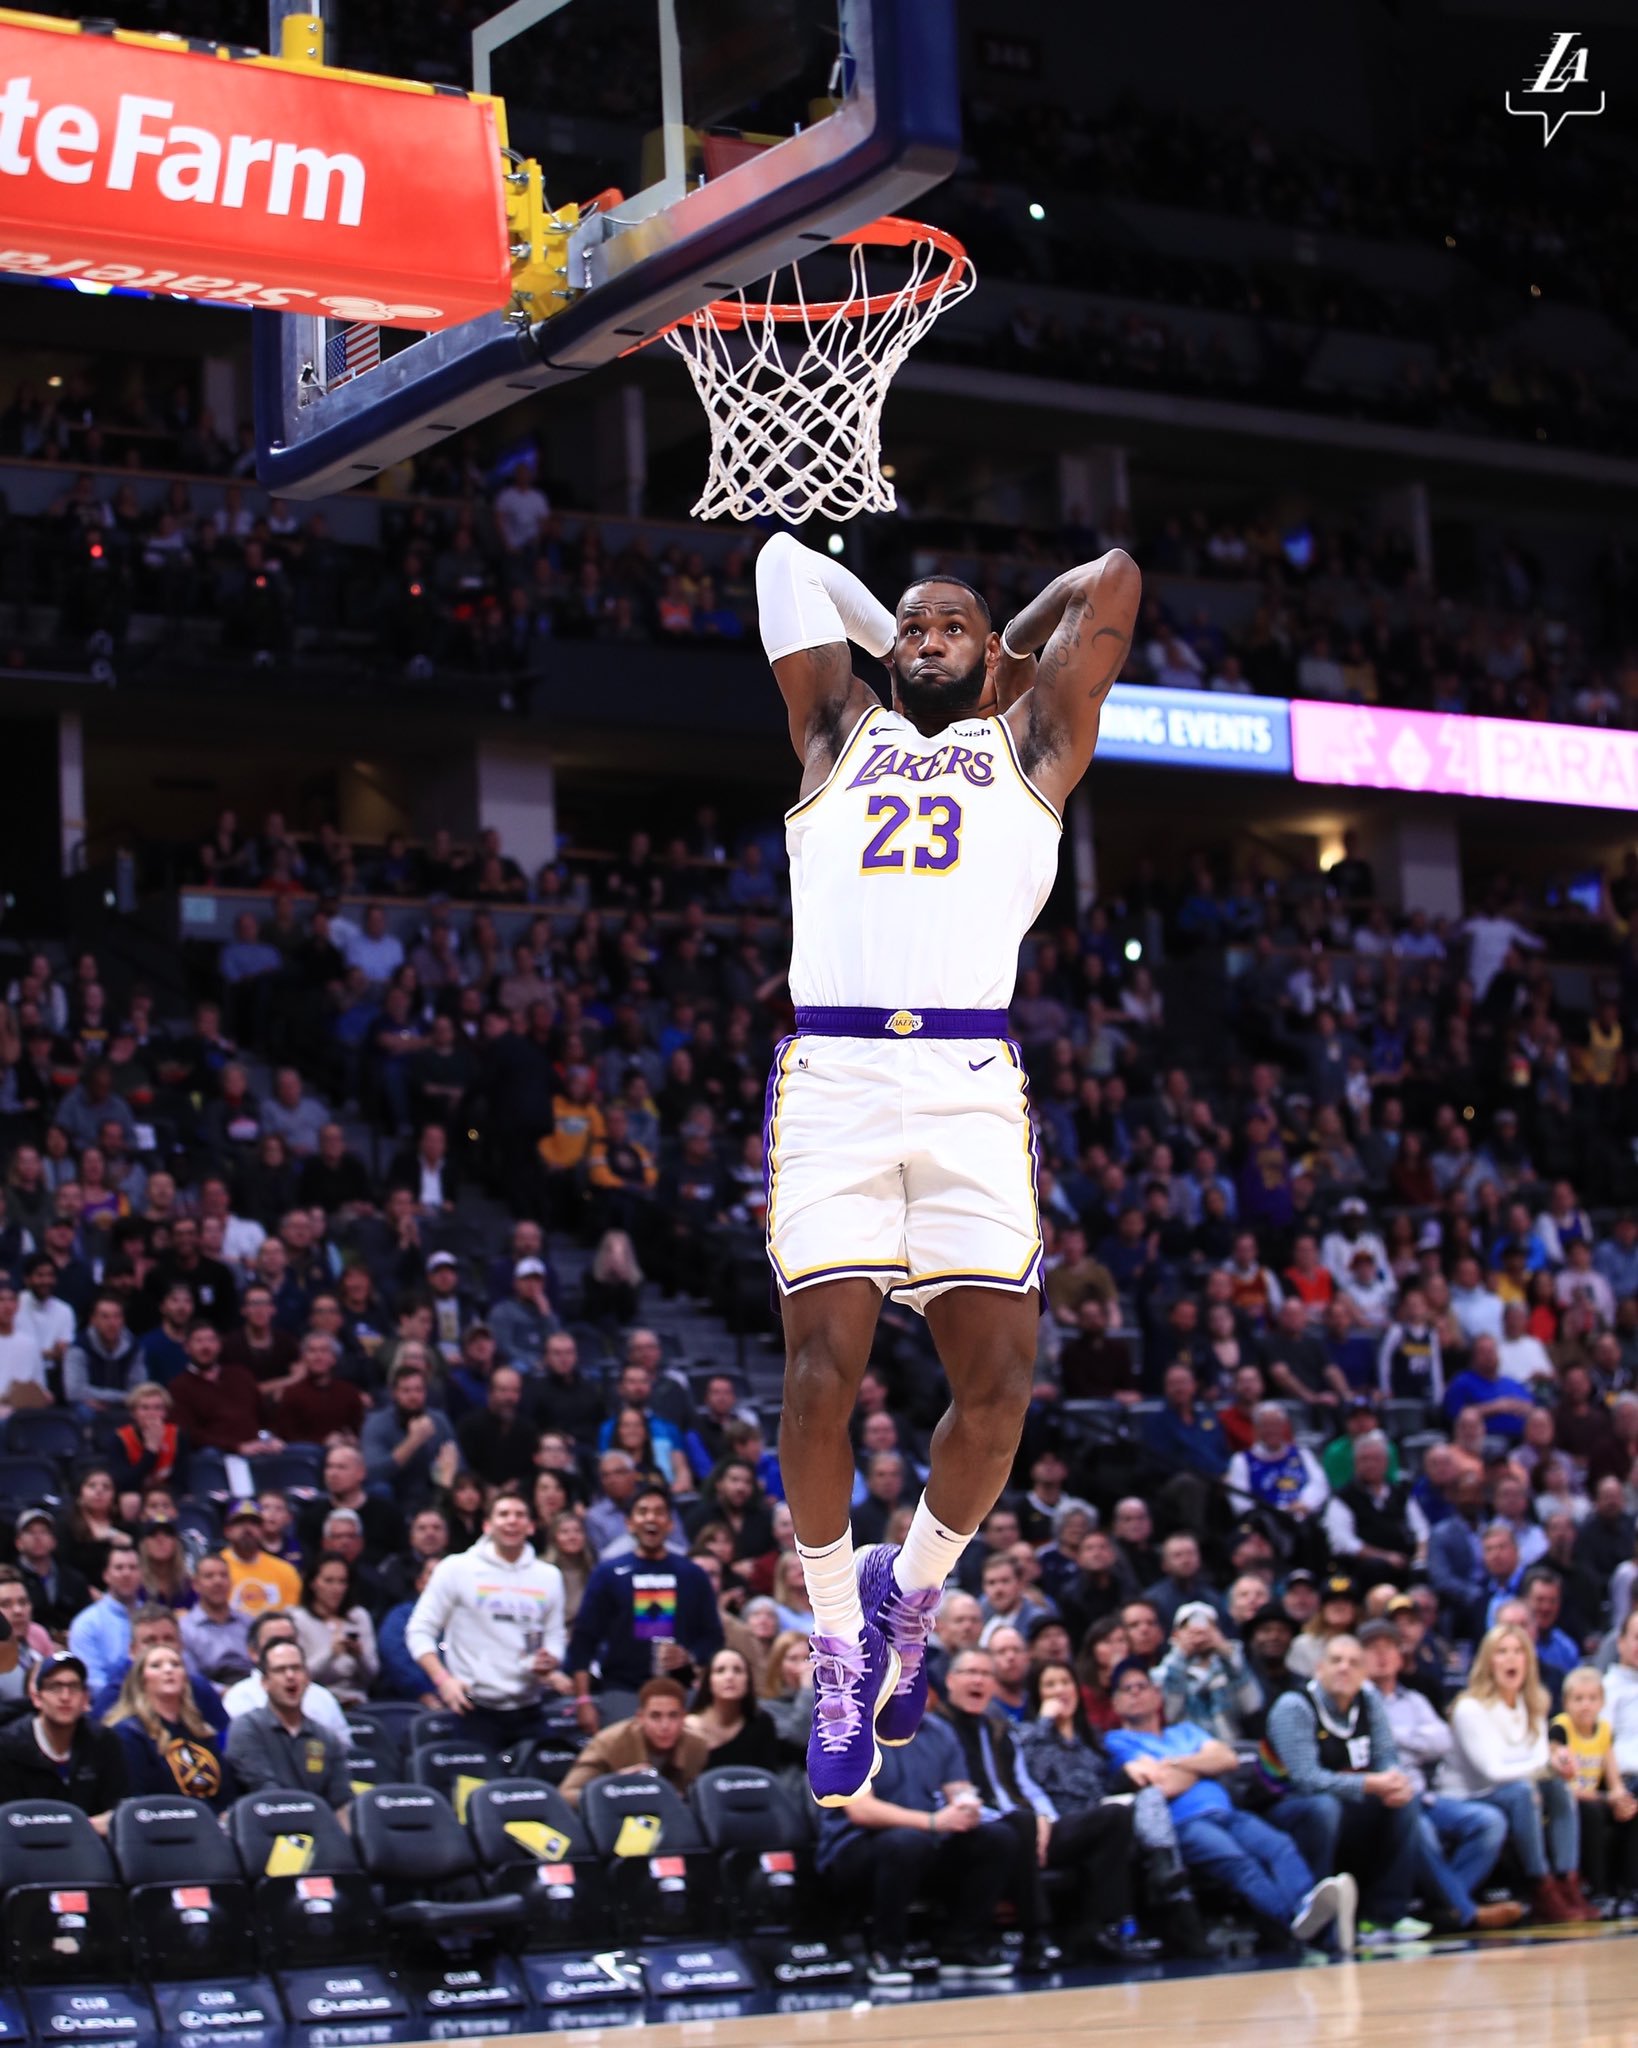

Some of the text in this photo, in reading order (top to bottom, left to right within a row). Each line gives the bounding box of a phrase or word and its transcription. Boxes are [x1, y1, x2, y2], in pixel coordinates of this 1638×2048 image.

[1168, 709, 1272, 754] EVENTS
[846, 744, 995, 790] LAKERS
[860, 793, 962, 876] 23
